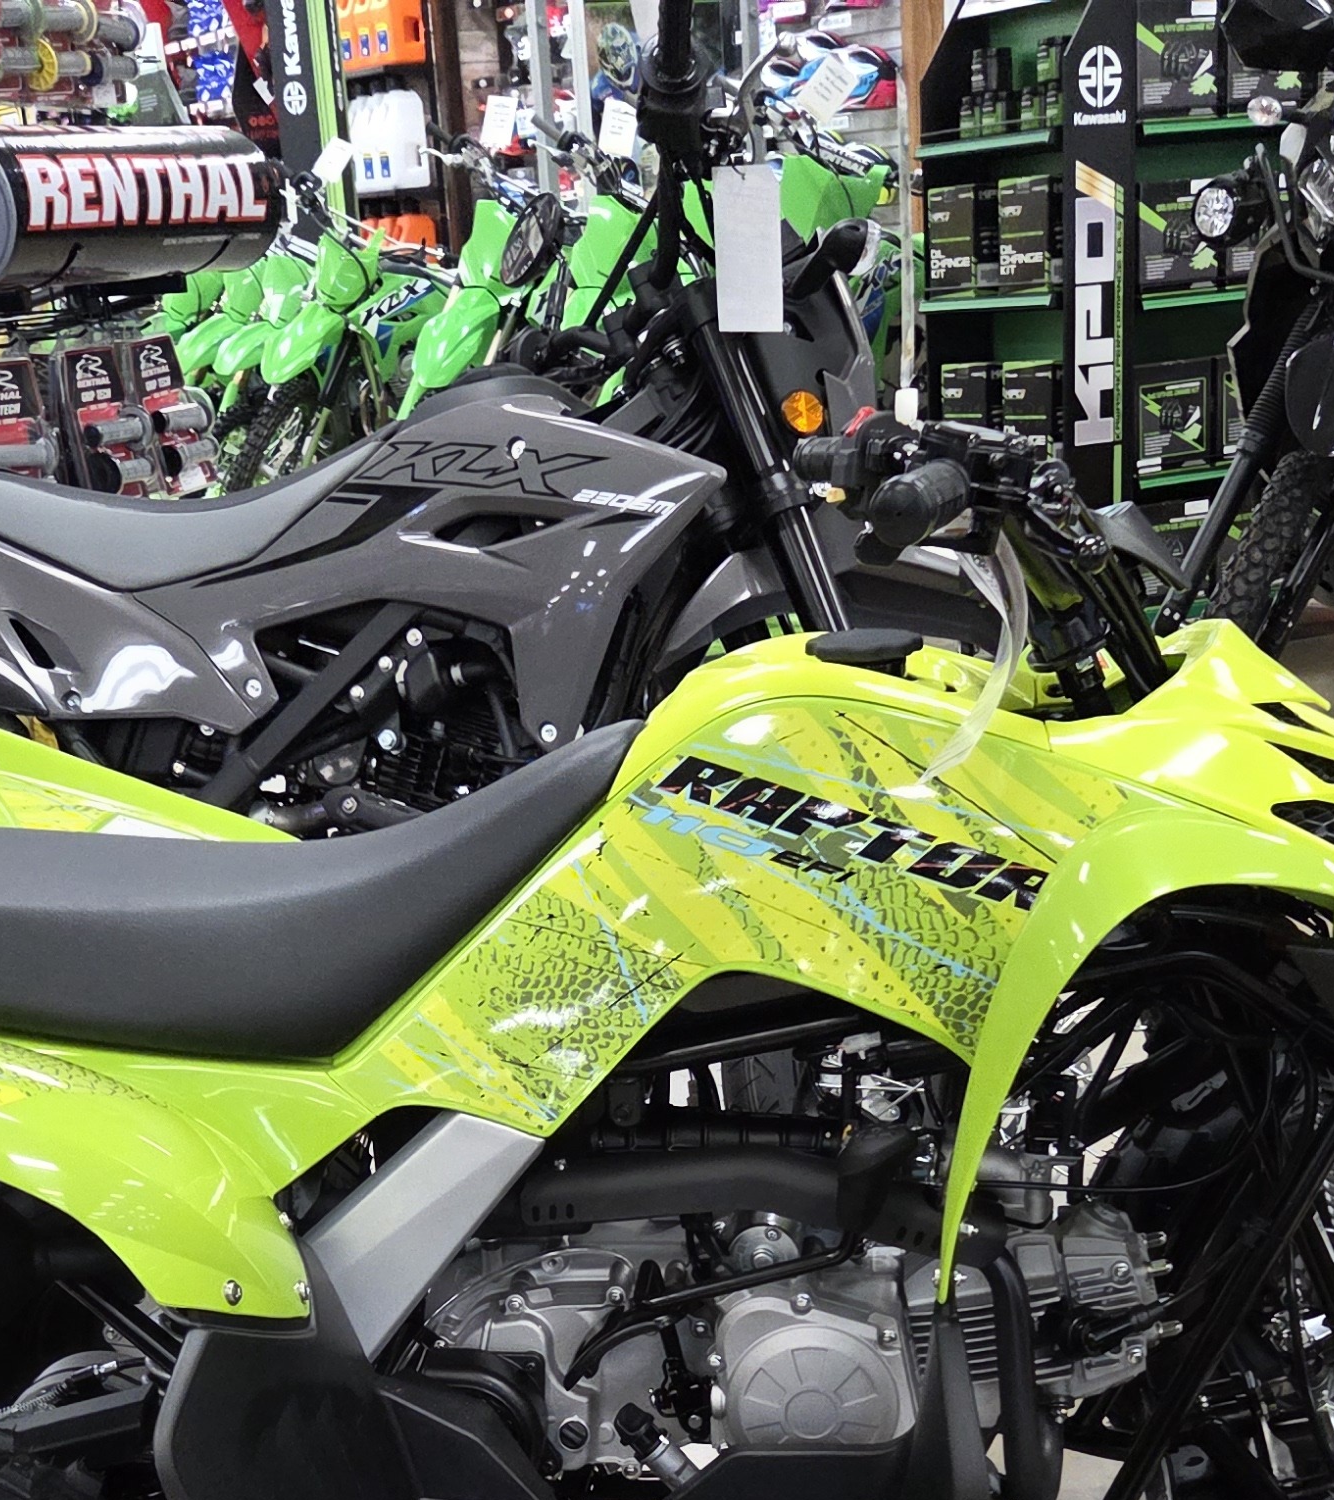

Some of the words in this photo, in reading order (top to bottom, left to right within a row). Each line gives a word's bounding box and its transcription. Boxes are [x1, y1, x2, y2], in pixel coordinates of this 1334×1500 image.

[282, 0, 303, 76] Kawa
[1073, 109, 1127, 126] Kawasaki
[17, 153, 268, 232] RENTHAL
[931, 269, 947, 279] KIT
[1000, 264, 1017, 276] KIT
[362, 278, 428, 325] KLX
[76, 376, 111, 389] RENTHAL
[0, 403, 21, 416] TECH
[354, 440, 610, 498] KLX
[650, 755, 1050, 911] RAPTOR
[769, 850, 857, 883] EFI
